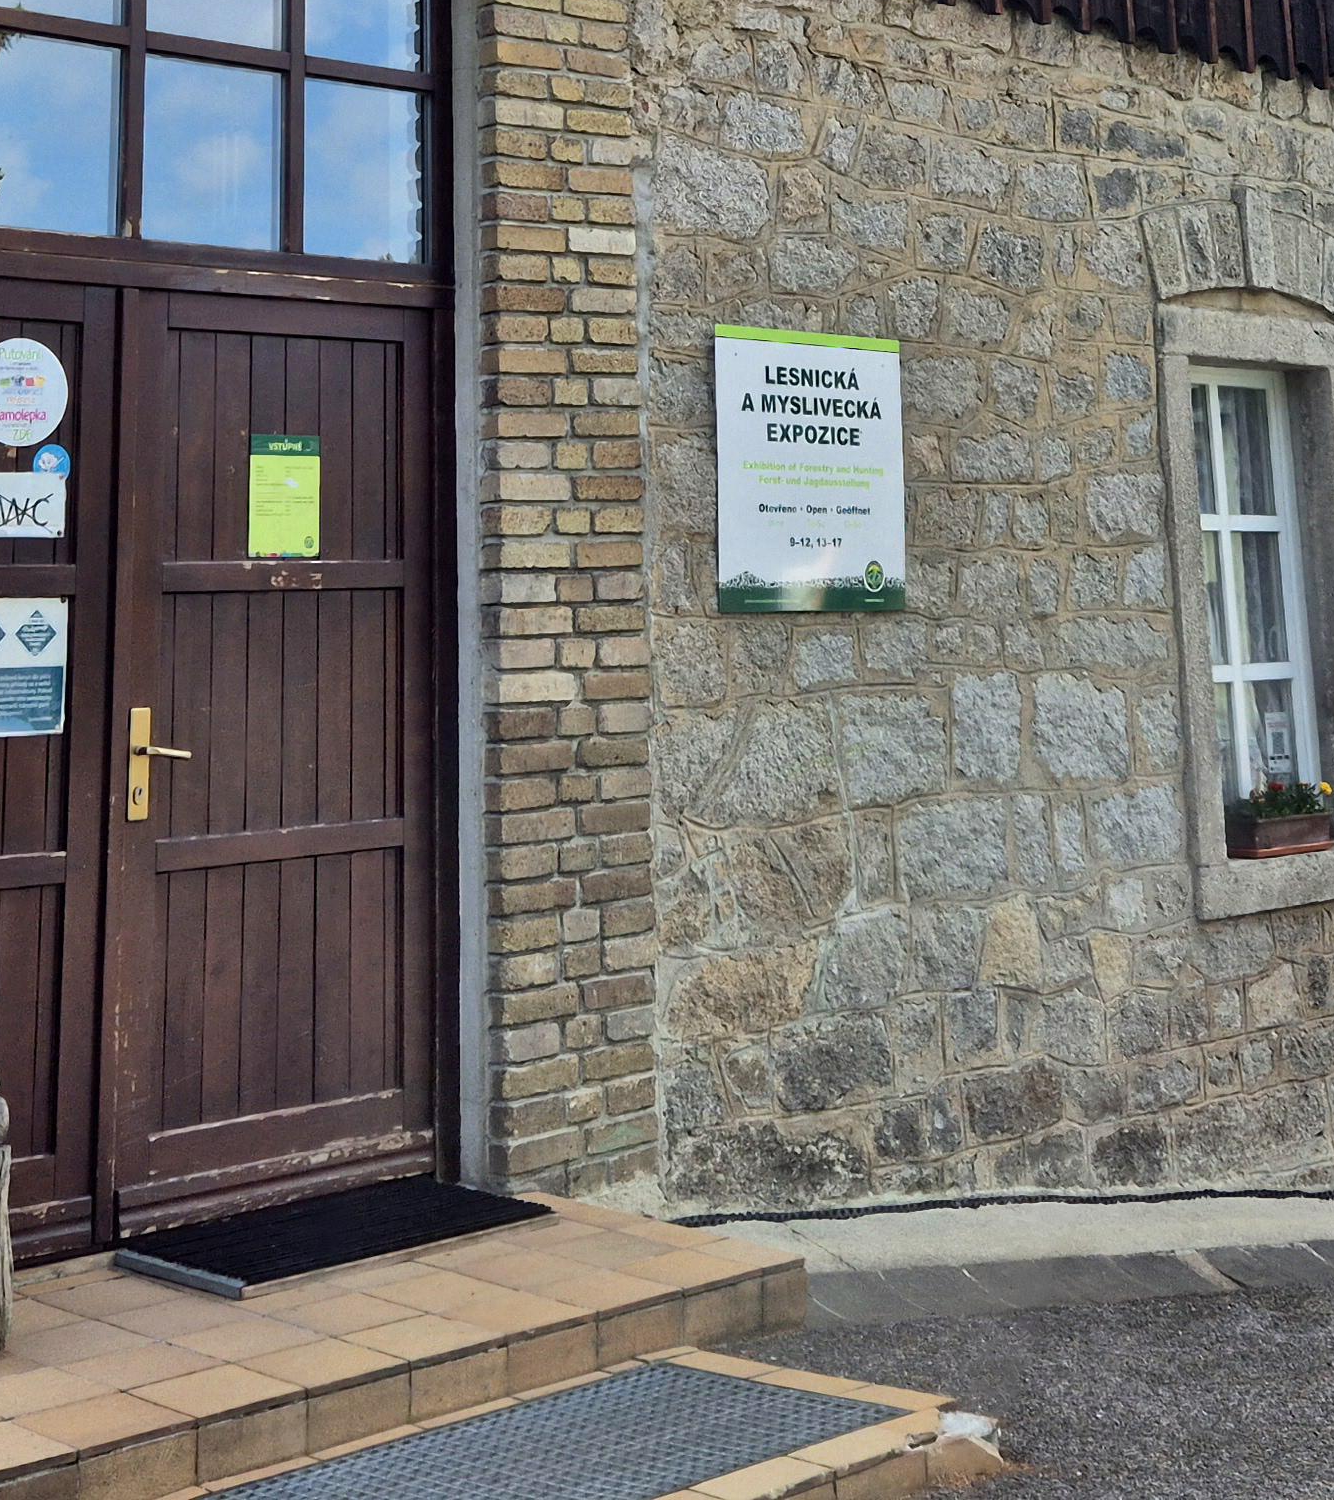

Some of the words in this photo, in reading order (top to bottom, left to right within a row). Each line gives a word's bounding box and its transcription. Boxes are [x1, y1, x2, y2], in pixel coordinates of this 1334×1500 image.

[765, 366, 860, 390] LESNICKÁ
[741, 393, 755, 412] A
[761, 394, 882, 419] MYSLIVECKÁ
[766, 423, 861, 446] EXPOZICE
[743, 461, 786, 472] Exhibition
[788, 462, 797, 471] of
[786, 477, 802, 485] und
[806, 504, 828, 515] Open
